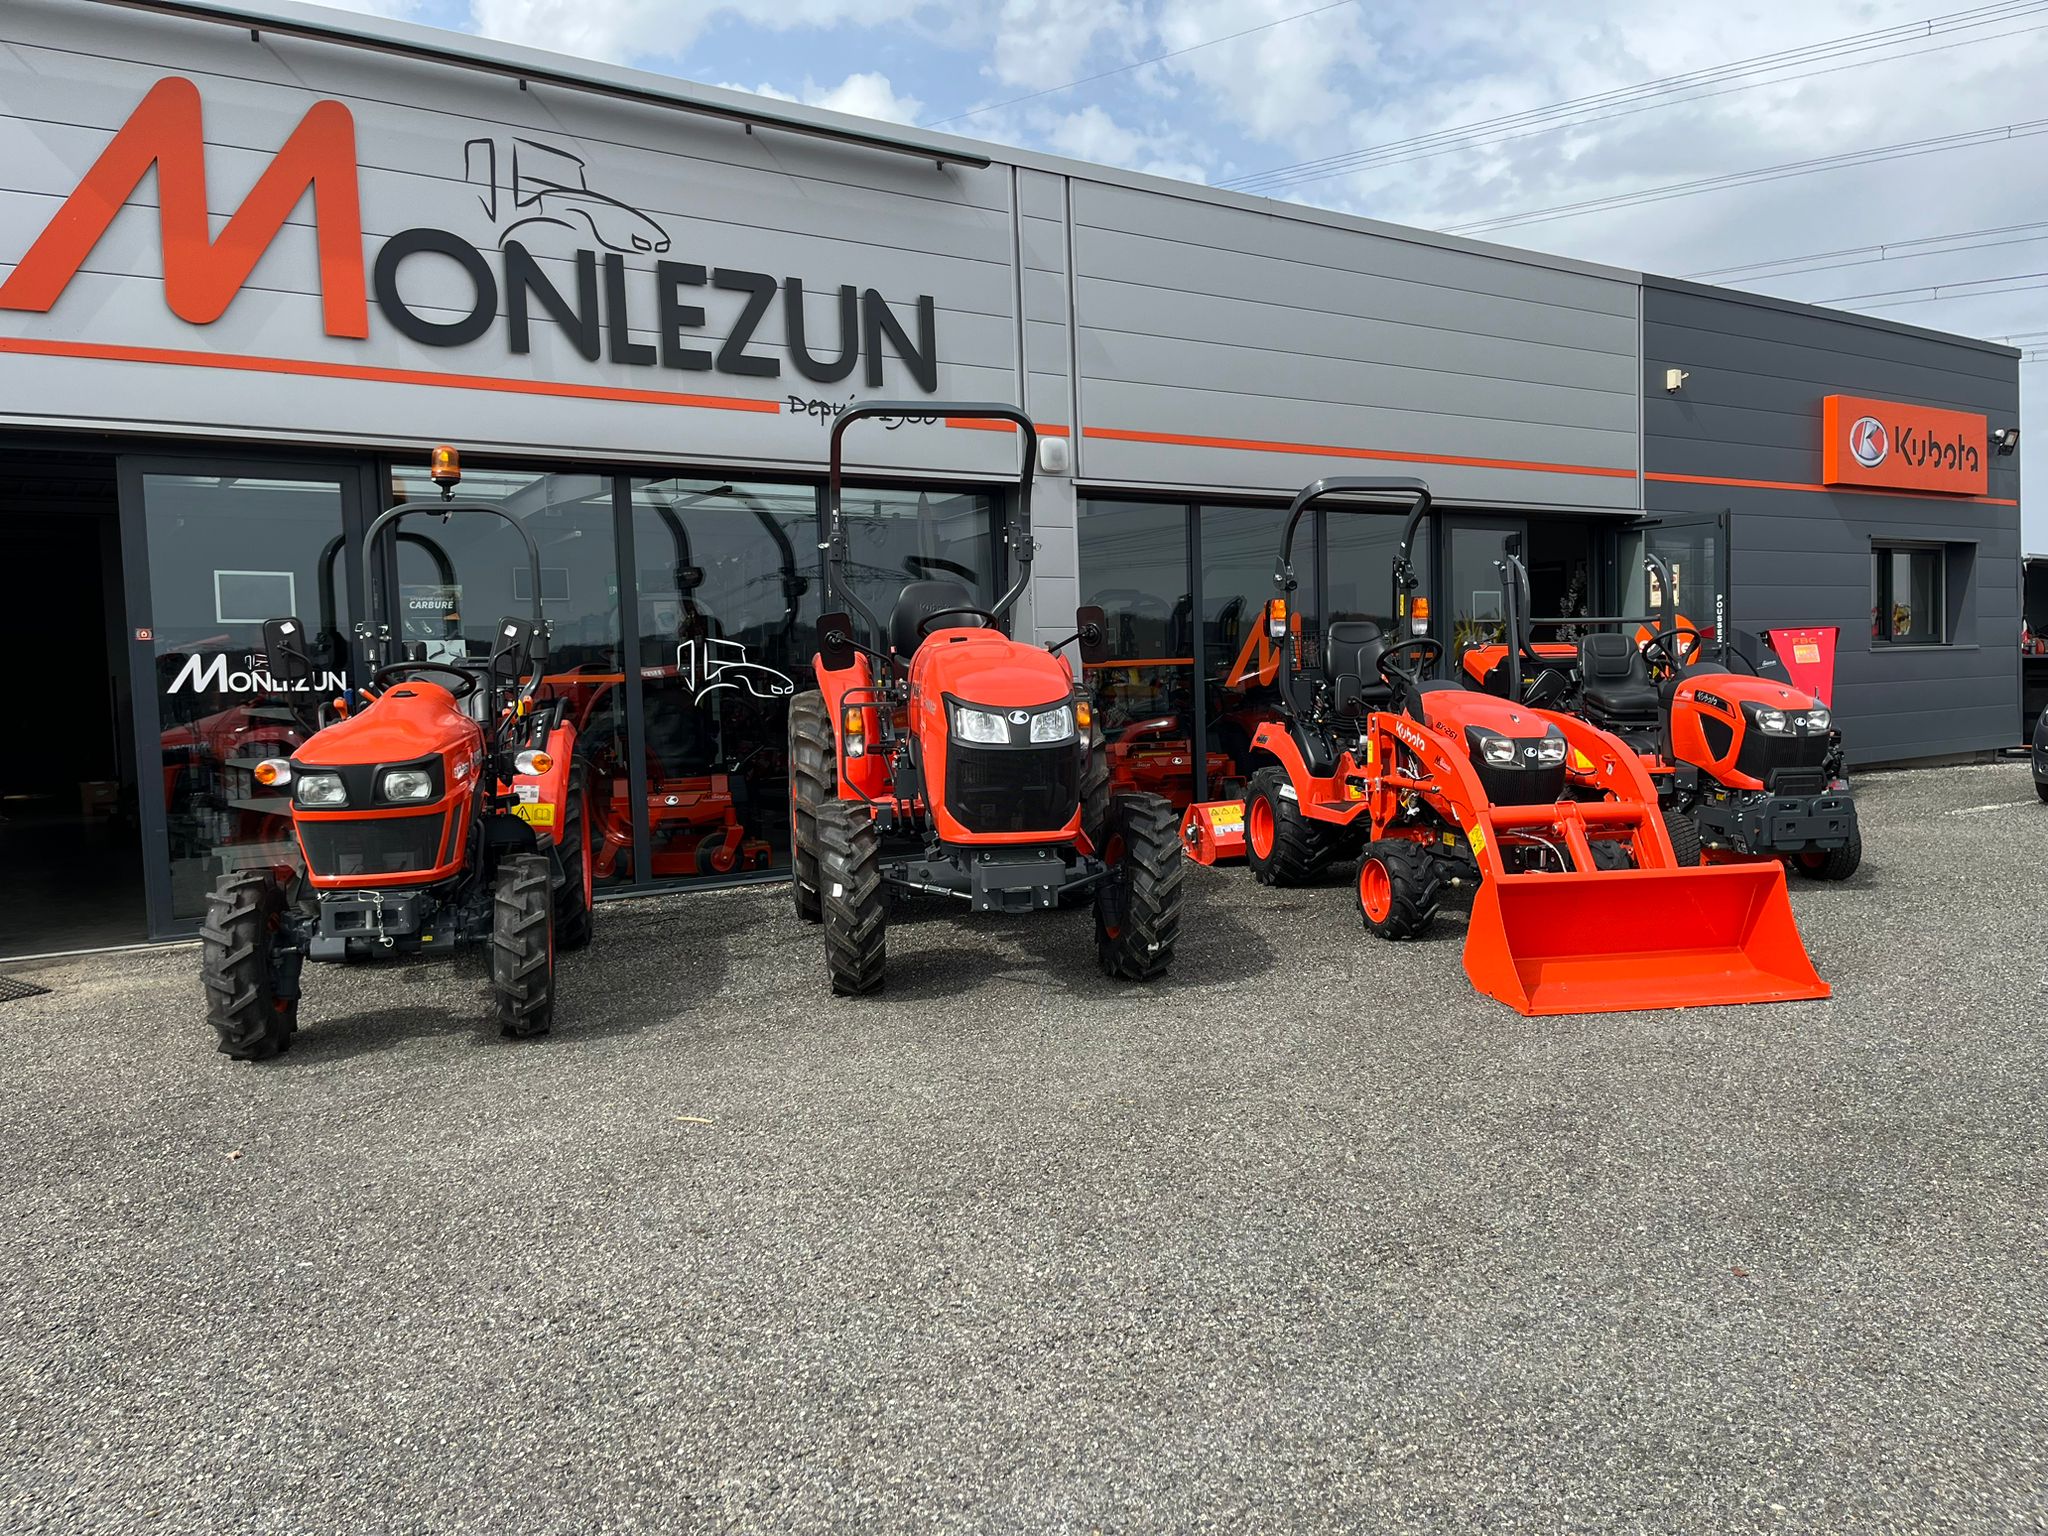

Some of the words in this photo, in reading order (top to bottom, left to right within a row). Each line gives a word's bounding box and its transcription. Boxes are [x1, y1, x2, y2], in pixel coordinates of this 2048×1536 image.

[0, 76, 937, 393] MONLEZUN
[787, 393, 871, 426] Depu
[1894, 425, 1979, 472] Kubota
[409, 601, 454, 609] CARBURE
[1716, 593, 1724, 644] POUSSEZ
[1395, 720, 1425, 752] Kubota
